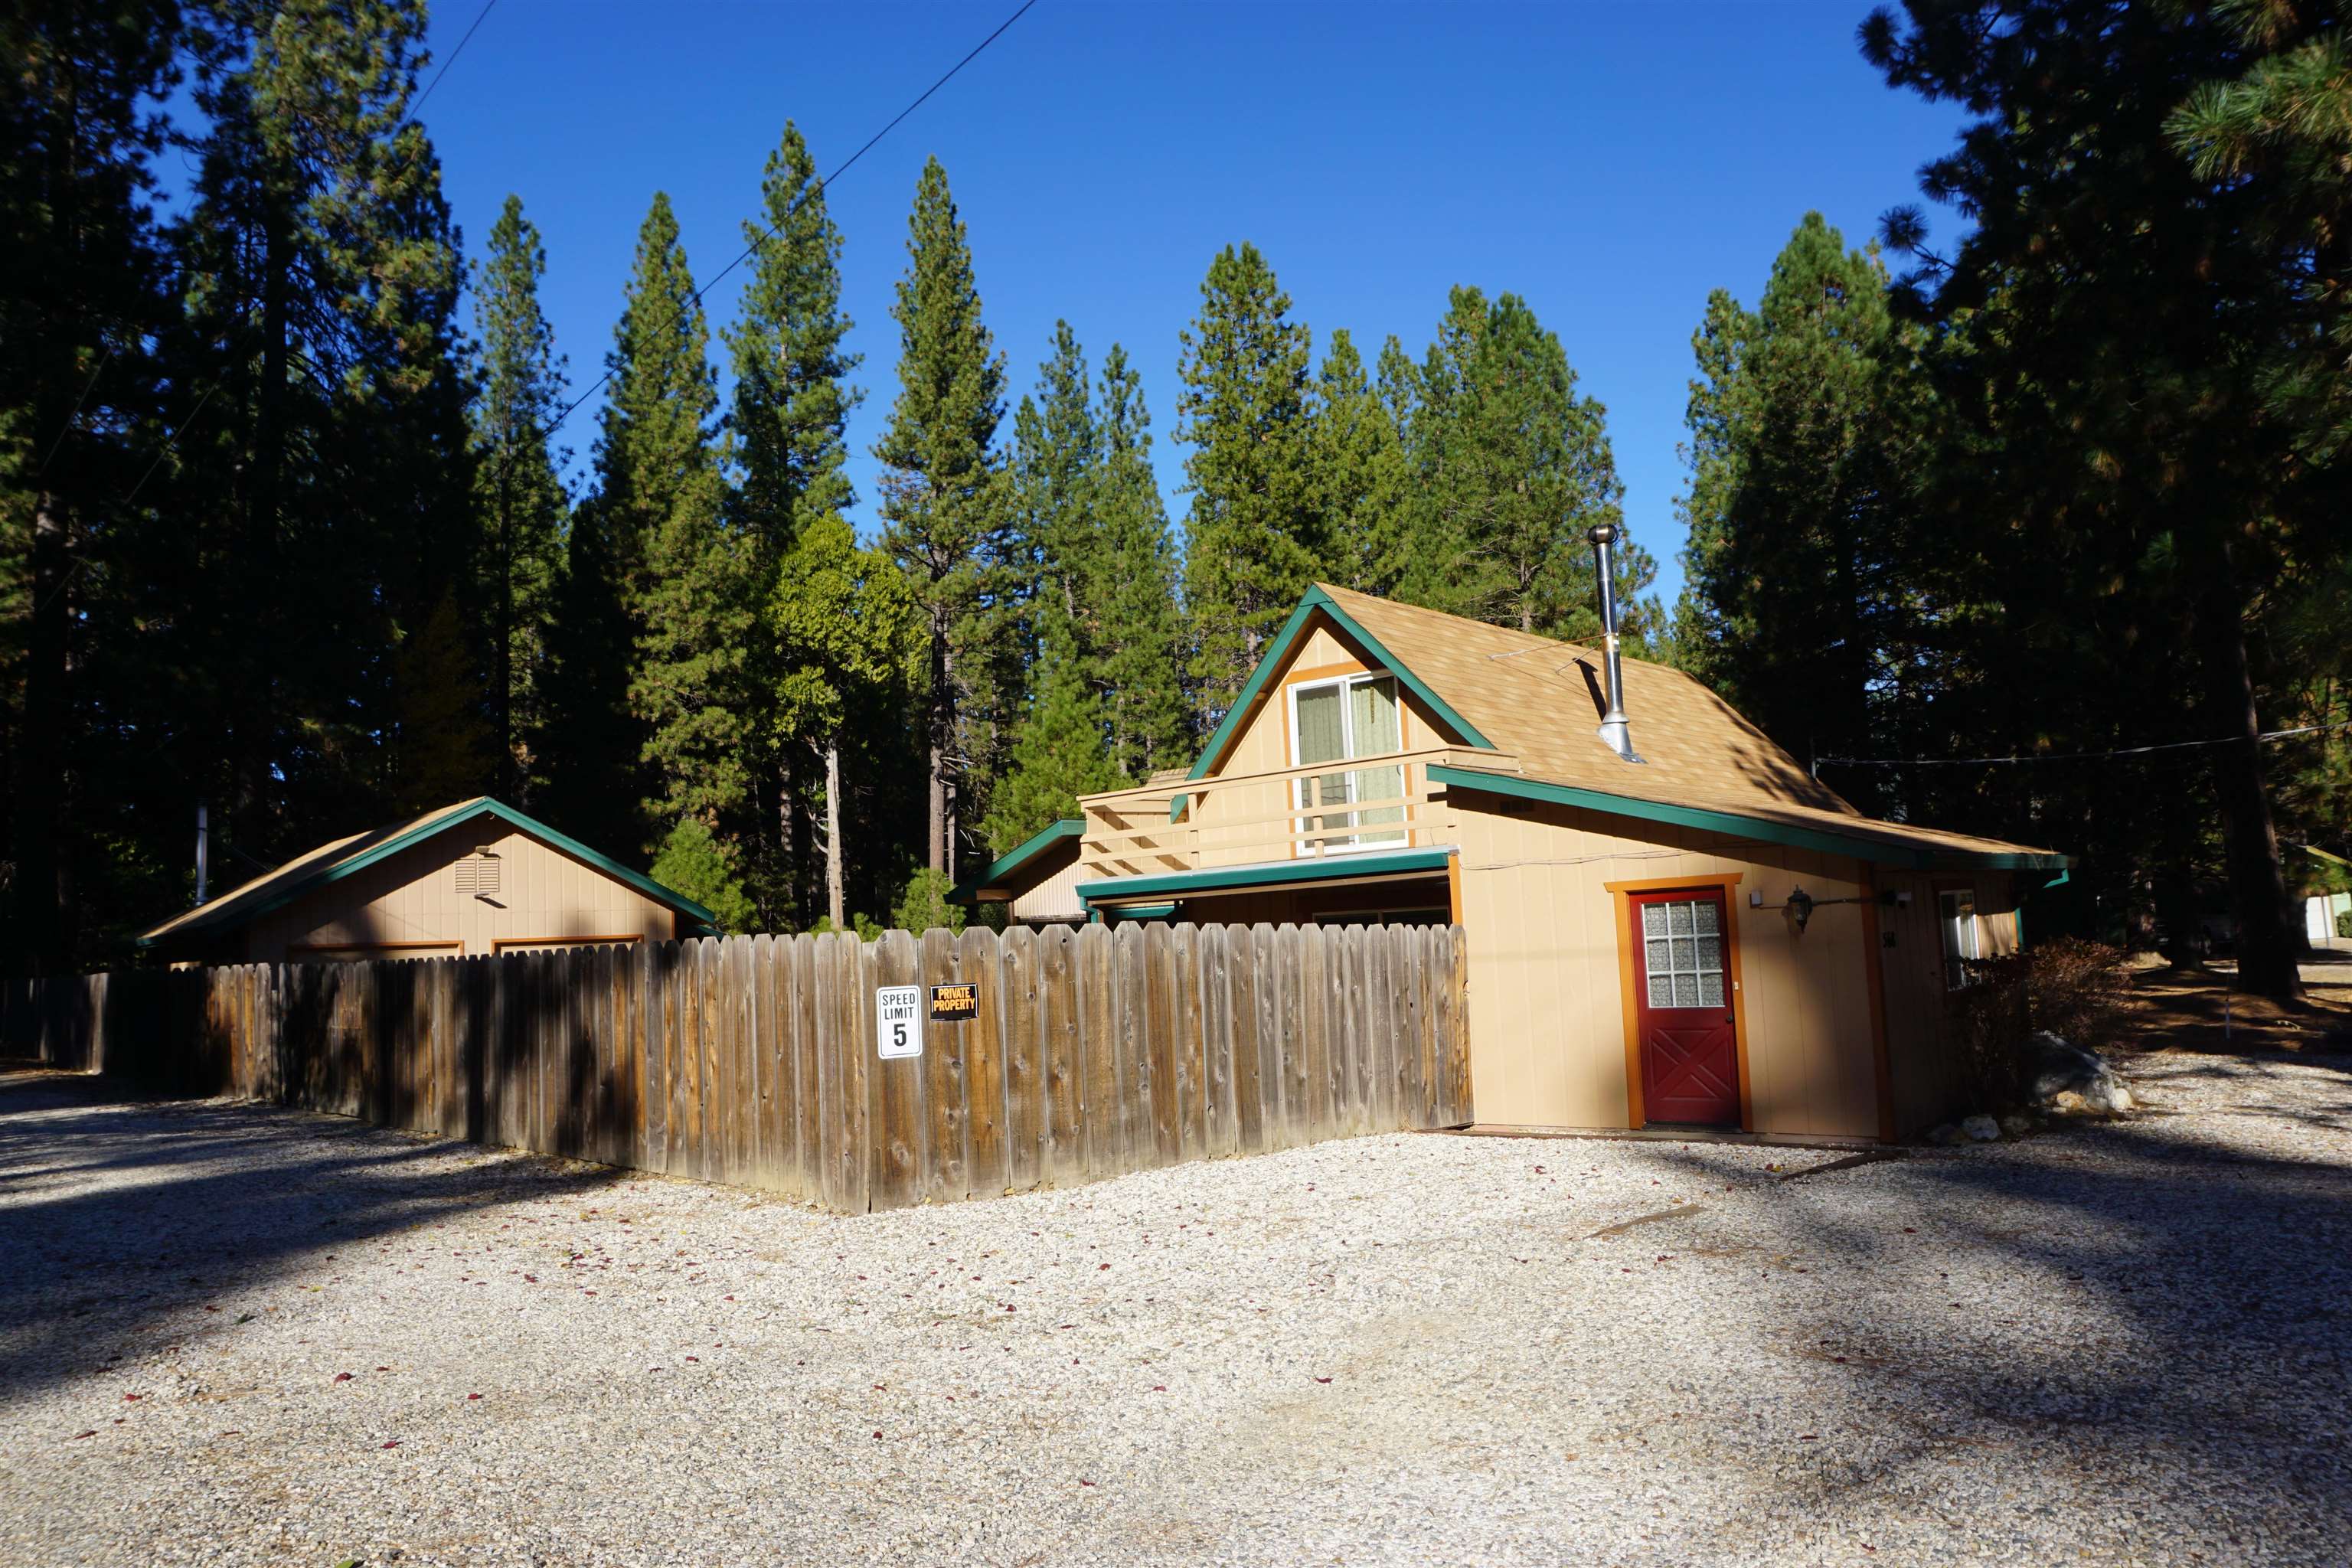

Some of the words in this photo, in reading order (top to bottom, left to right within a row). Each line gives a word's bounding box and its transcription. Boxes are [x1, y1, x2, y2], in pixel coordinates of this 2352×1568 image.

[883, 994, 915, 1005] SPEED
[939, 987, 970, 999] PRIVATE
[933, 998, 975, 1011] PROPERTY
[884, 1007, 914, 1020] LIMIT
[893, 1024, 906, 1047] 5
